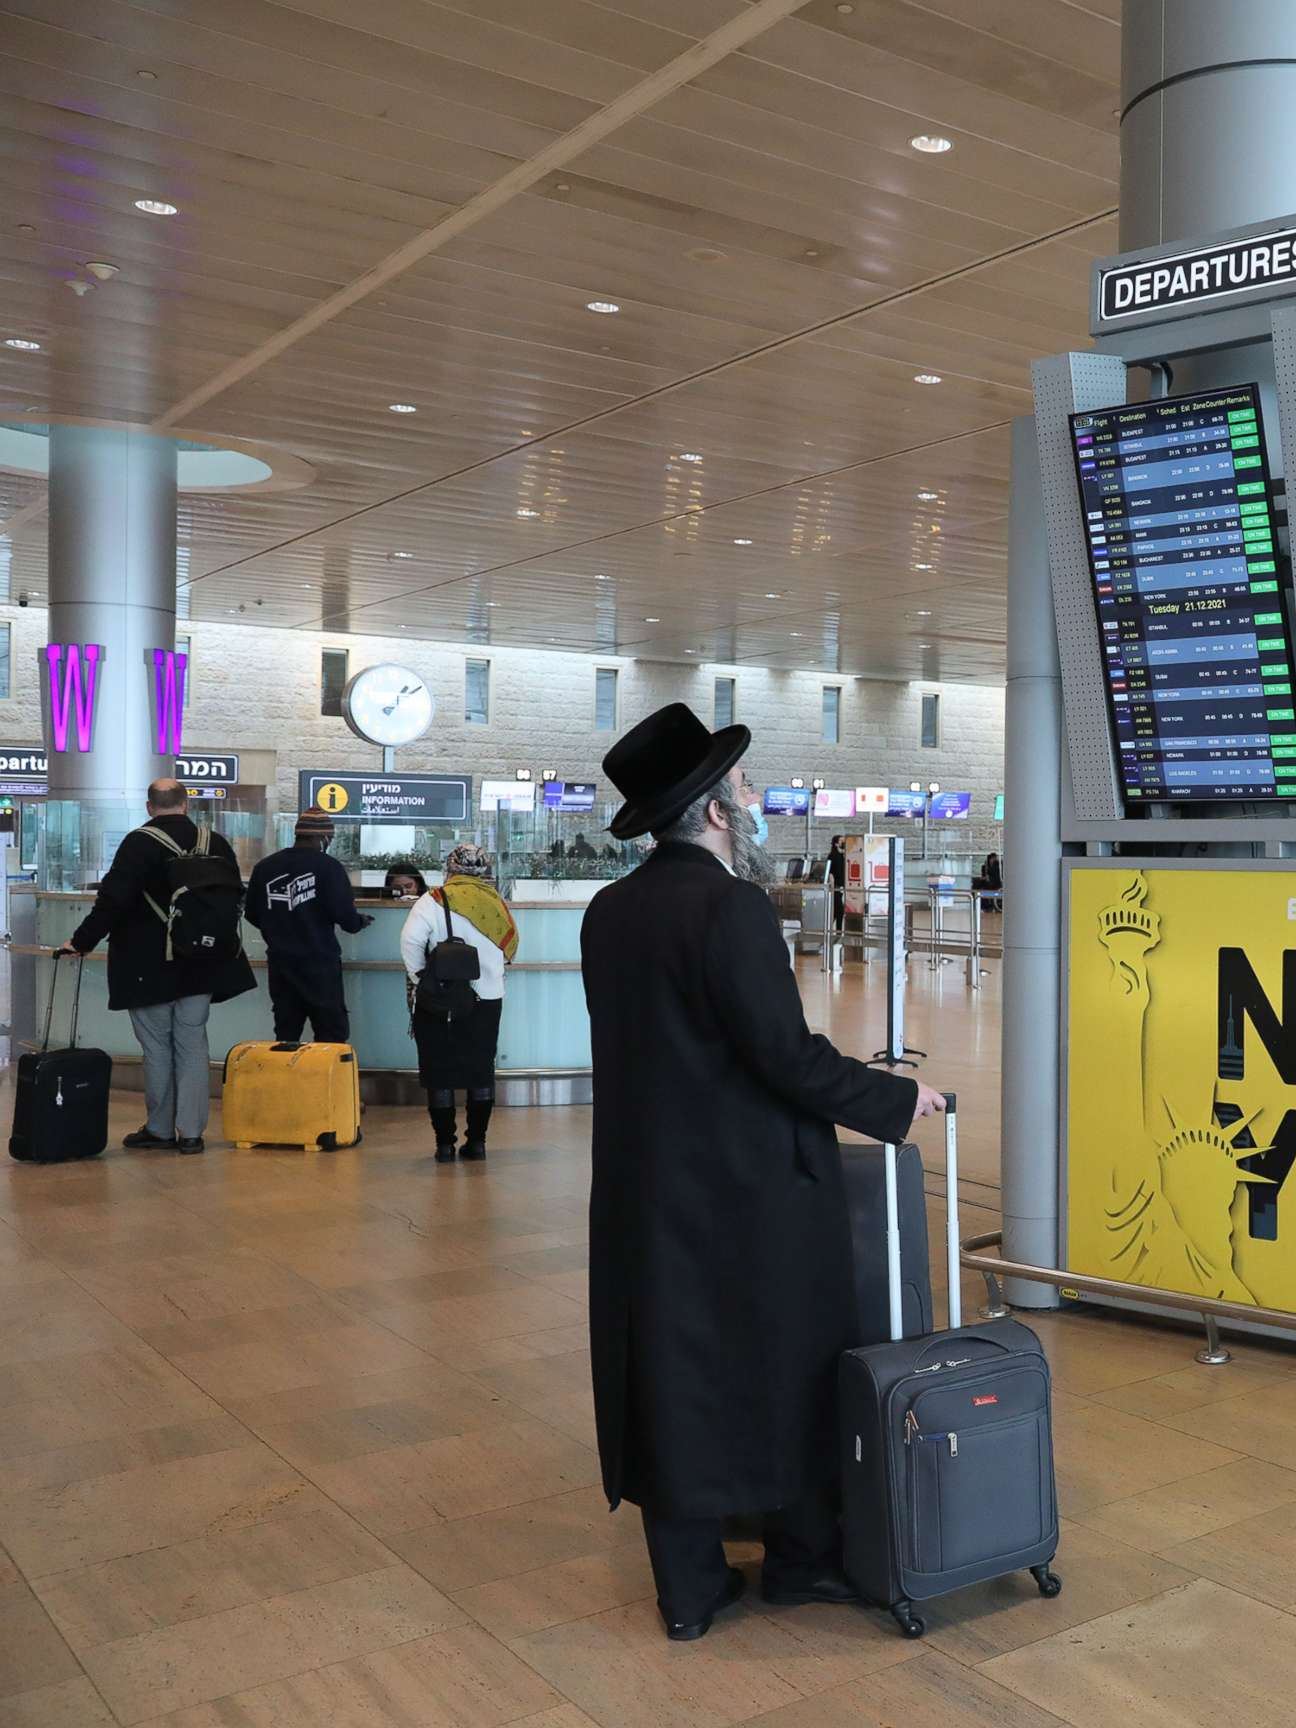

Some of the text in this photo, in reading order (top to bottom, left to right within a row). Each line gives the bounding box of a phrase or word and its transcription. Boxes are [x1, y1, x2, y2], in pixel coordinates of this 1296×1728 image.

[1093, 419, 1107, 427] Flight
[1119, 413, 1146, 422] Destination
[1159, 407, 1176, 415] Sched
[1180, 404, 1190, 412] Est
[1205, 399, 1226, 407] Counter
[1226, 395, 1250, 403] Remarks
[1148, 599, 1226, 614] Tuesday 21.12.2021
[46, 643, 101, 753] W
[153, 648, 187, 756] W
[361, 783, 402, 796] מודיעין
[361, 795, 426, 807] INFORMATION
